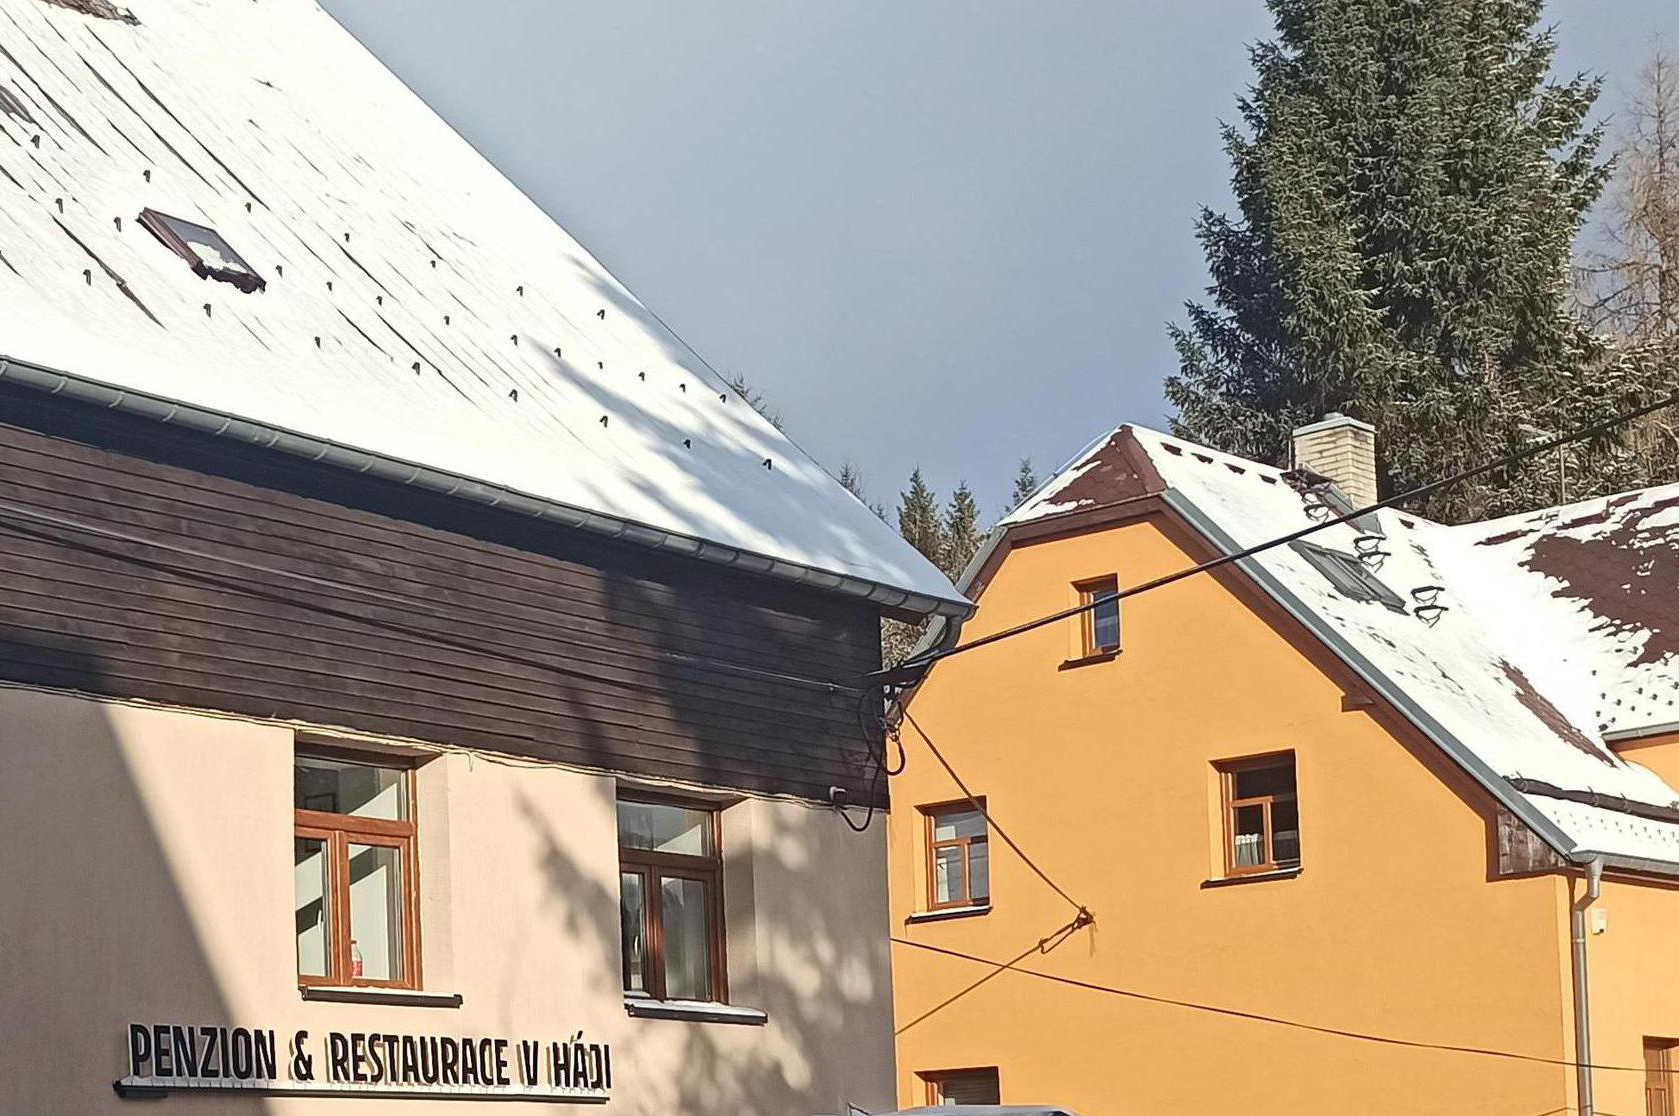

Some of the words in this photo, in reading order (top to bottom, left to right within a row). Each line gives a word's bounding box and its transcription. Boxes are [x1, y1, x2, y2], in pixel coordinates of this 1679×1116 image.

[129, 1023, 277, 1080] PENZION
[294, 1030, 315, 1081] &
[329, 1031, 511, 1086] RESTAURACE
[522, 1039, 539, 1086] V
[552, 1030, 611, 1089] HÁJI
